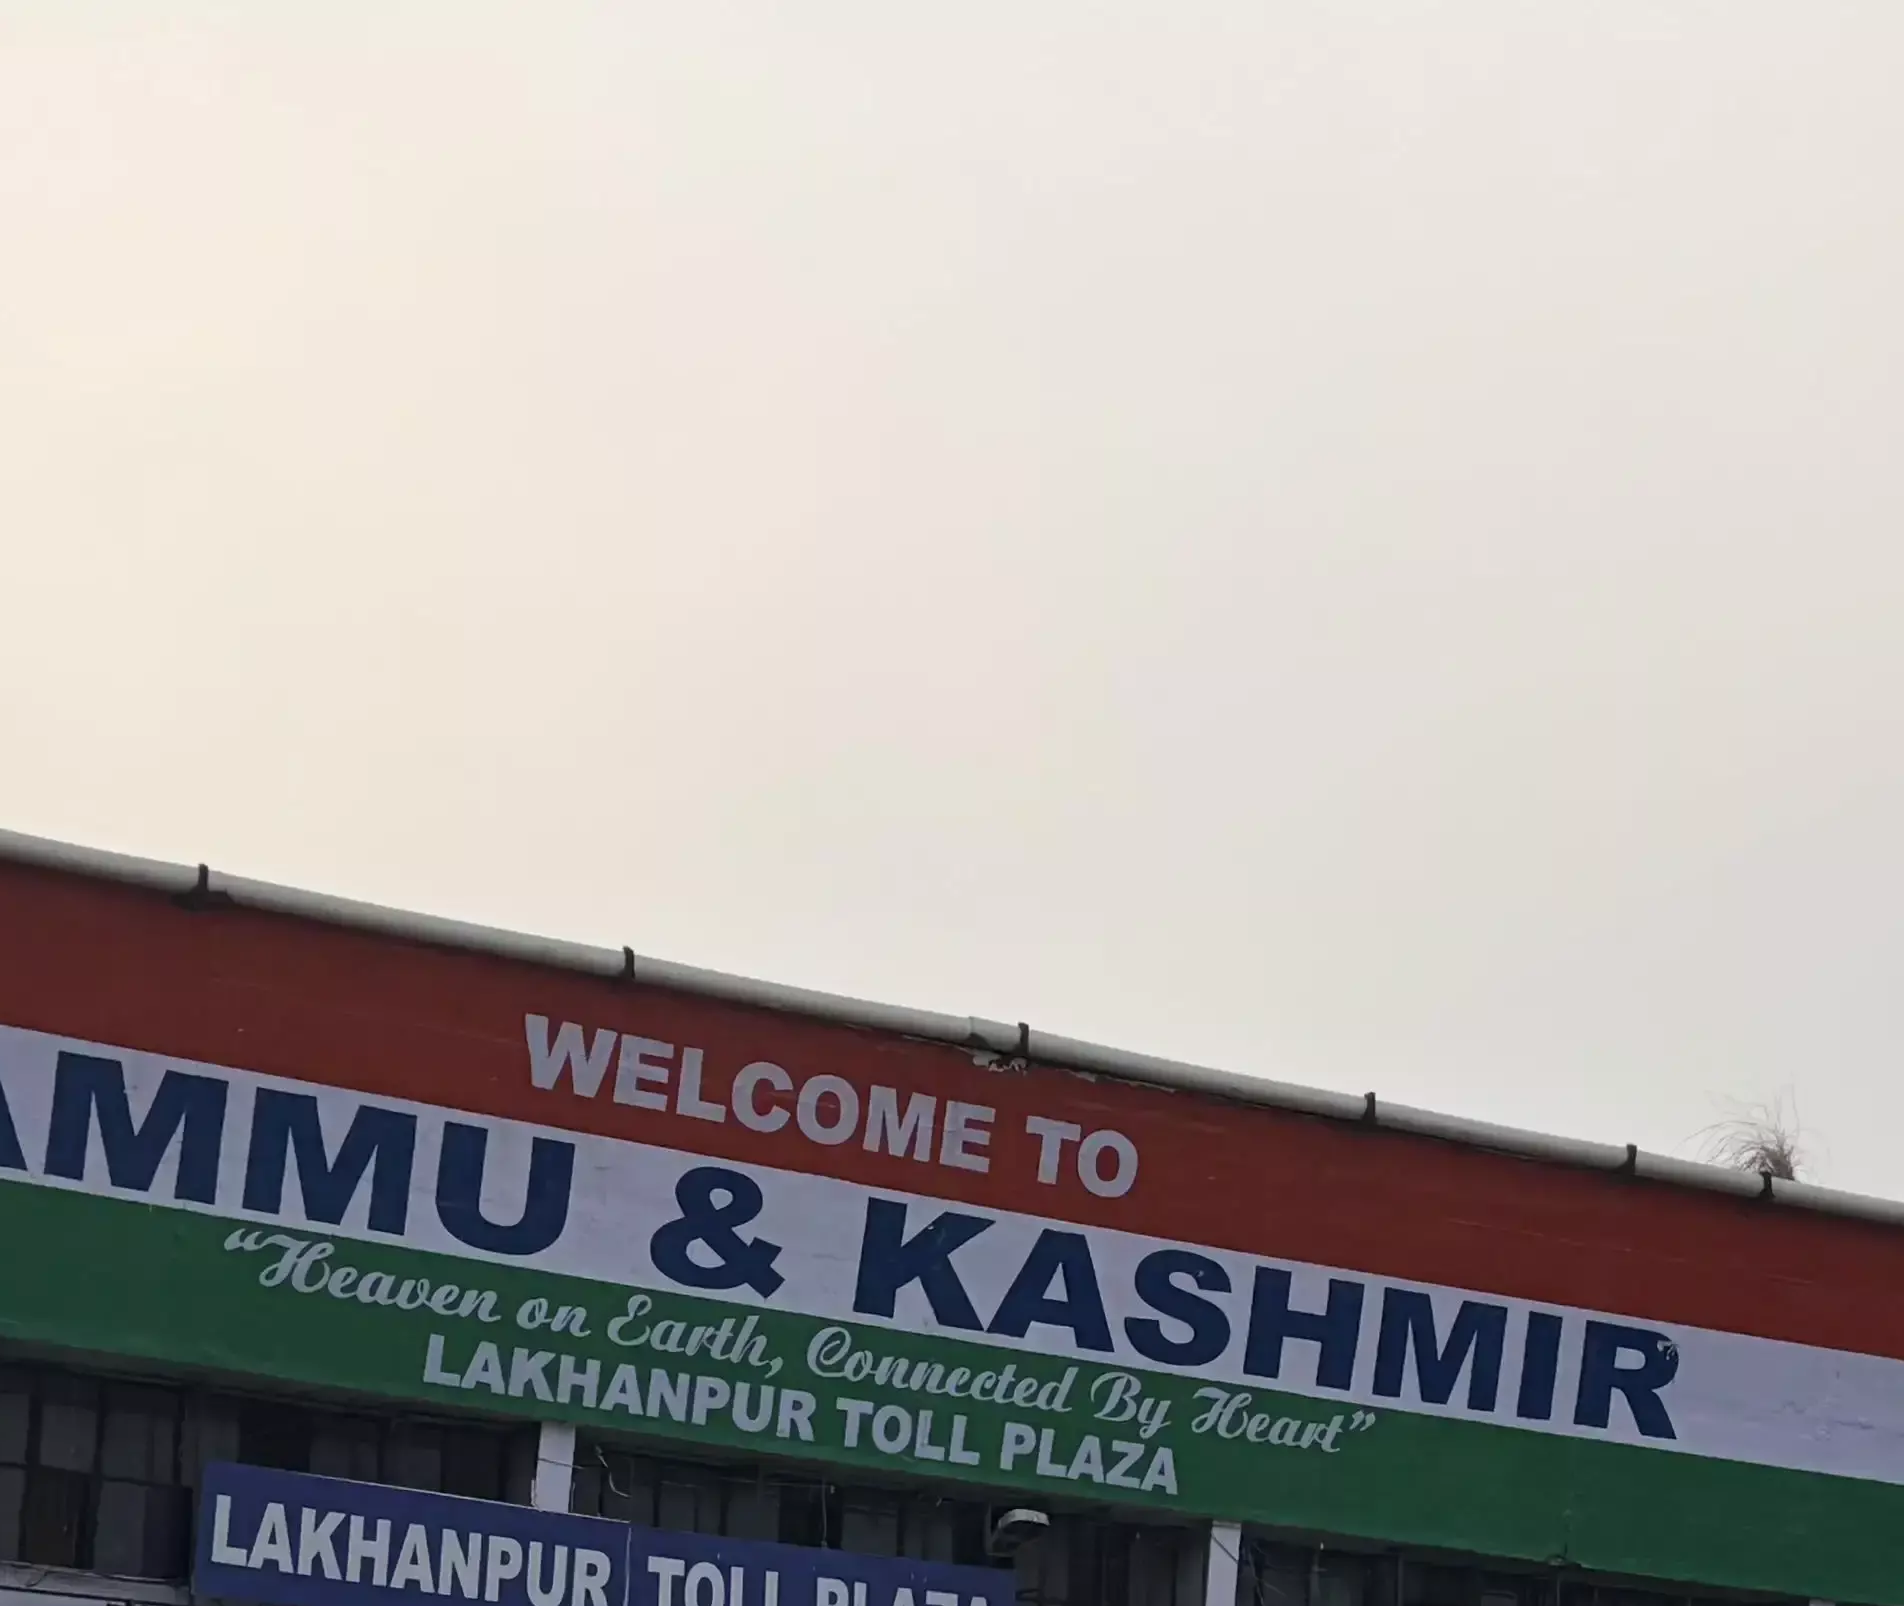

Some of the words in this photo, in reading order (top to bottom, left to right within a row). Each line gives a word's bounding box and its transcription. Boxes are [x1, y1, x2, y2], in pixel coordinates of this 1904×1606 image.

[524, 1012, 997, 1174] WELCOME
[1025, 1115, 1138, 1199] TO
[516, 1296, 591, 1338] on
[607, 1293, 784, 1379] Earth,
[806, 1326, 1080, 1413] Connected
[1091, 1371, 1172, 1440] By
[649, 1165, 786, 1299] &
[852, 1196, 1680, 1441] KASHMIR
[423, 1333, 817, 1443] LAKHANPUR
[836, 1396, 980, 1466] TOLL
[999, 1421, 1179, 1496] PLAZA
